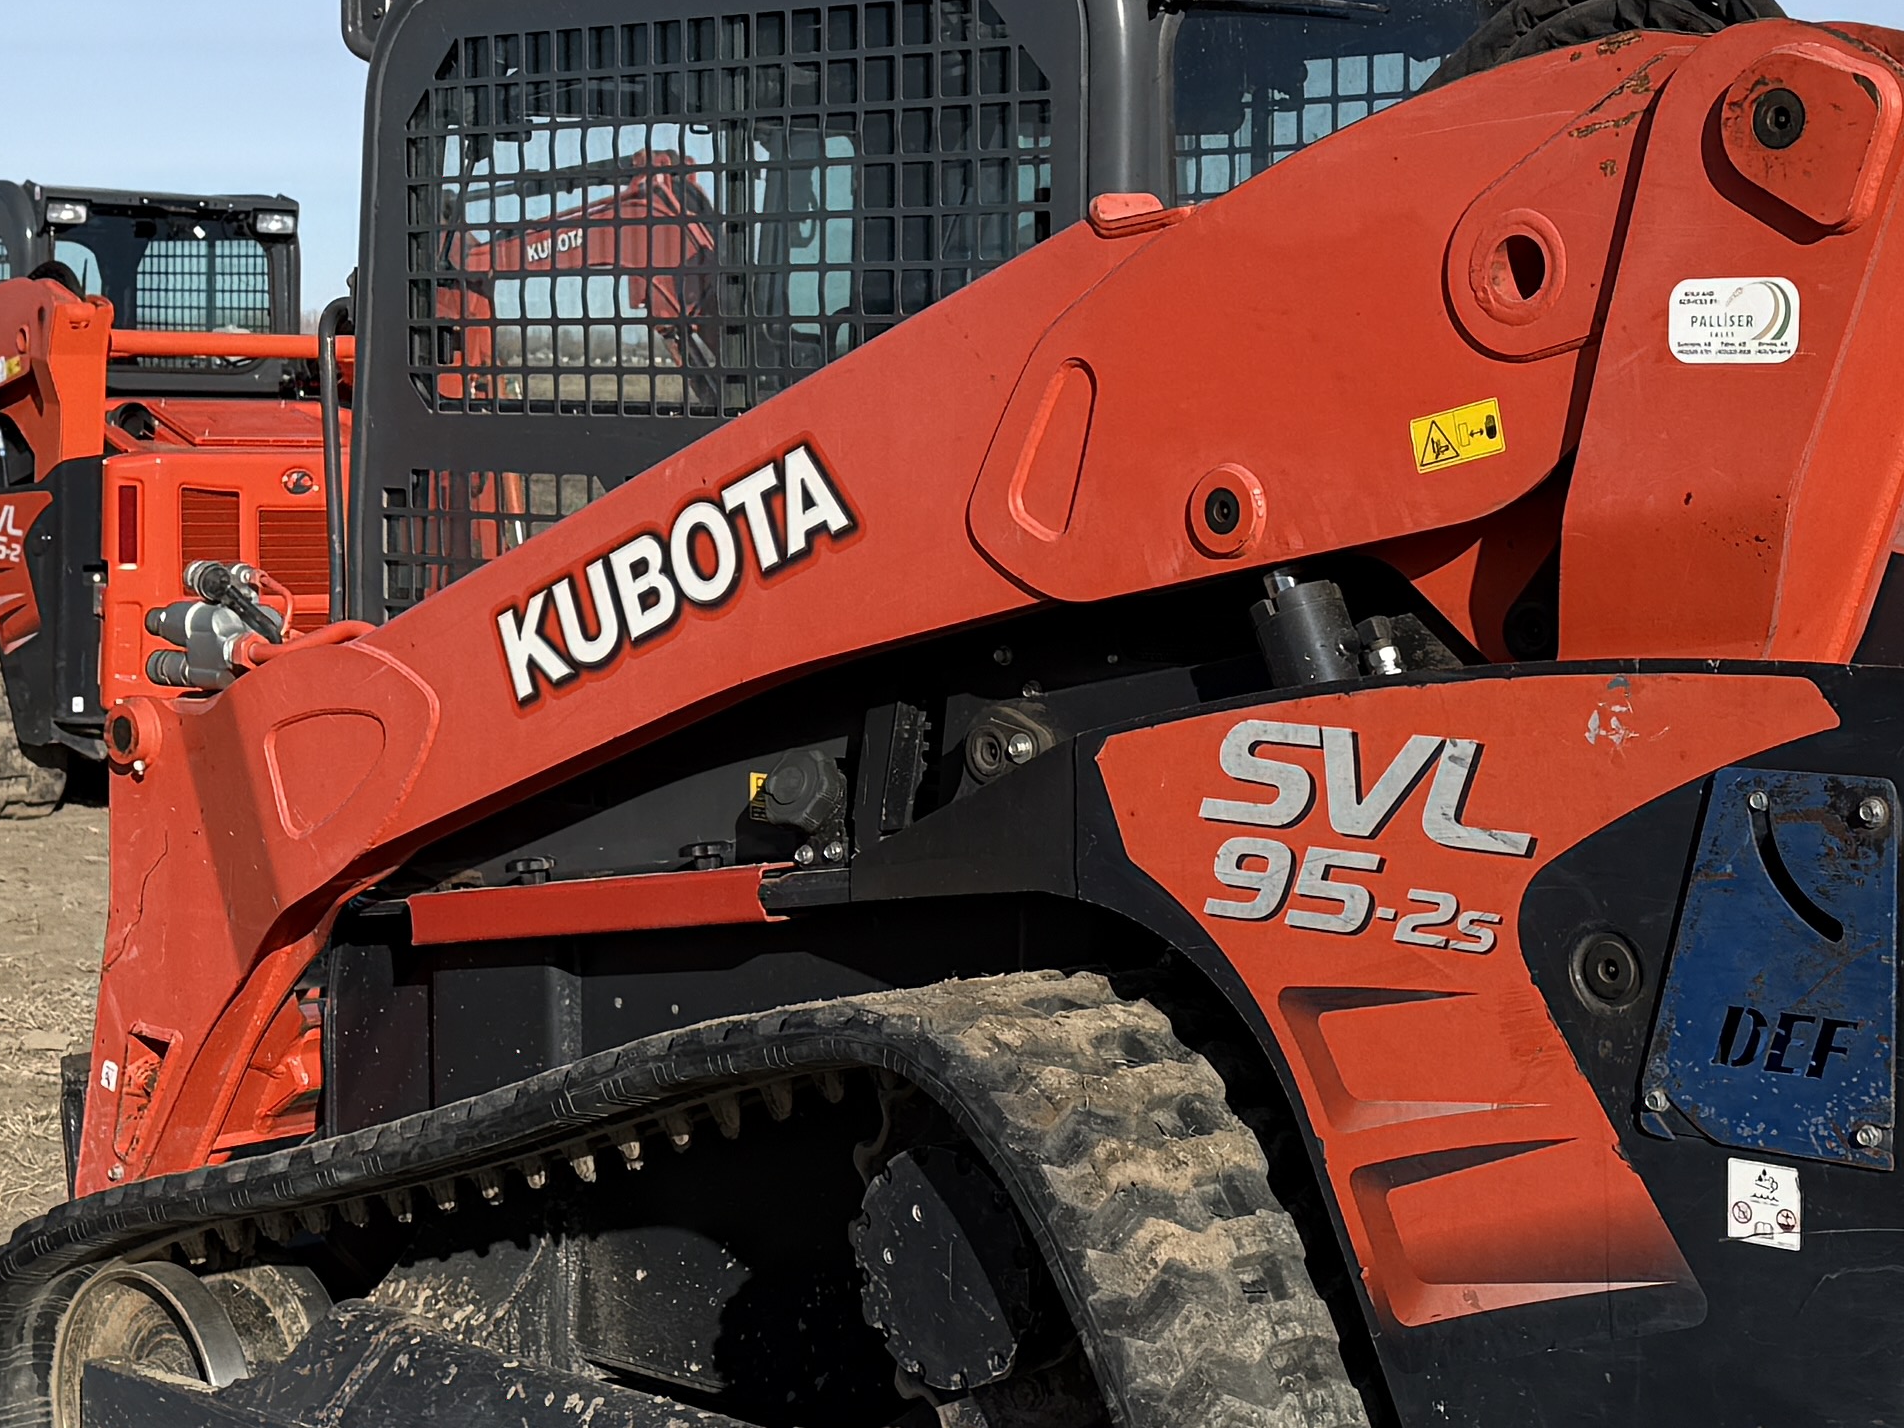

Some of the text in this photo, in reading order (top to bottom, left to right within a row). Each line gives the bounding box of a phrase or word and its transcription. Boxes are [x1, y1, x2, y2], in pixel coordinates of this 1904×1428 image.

[527, 228, 583, 262] KUOT
[1691, 312, 1753, 327] PALLISER
[497, 445, 853, 702] KUBOTA
[1198, 719, 1535, 857] SVL
[1709, 1004, 1860, 1080] DEF
